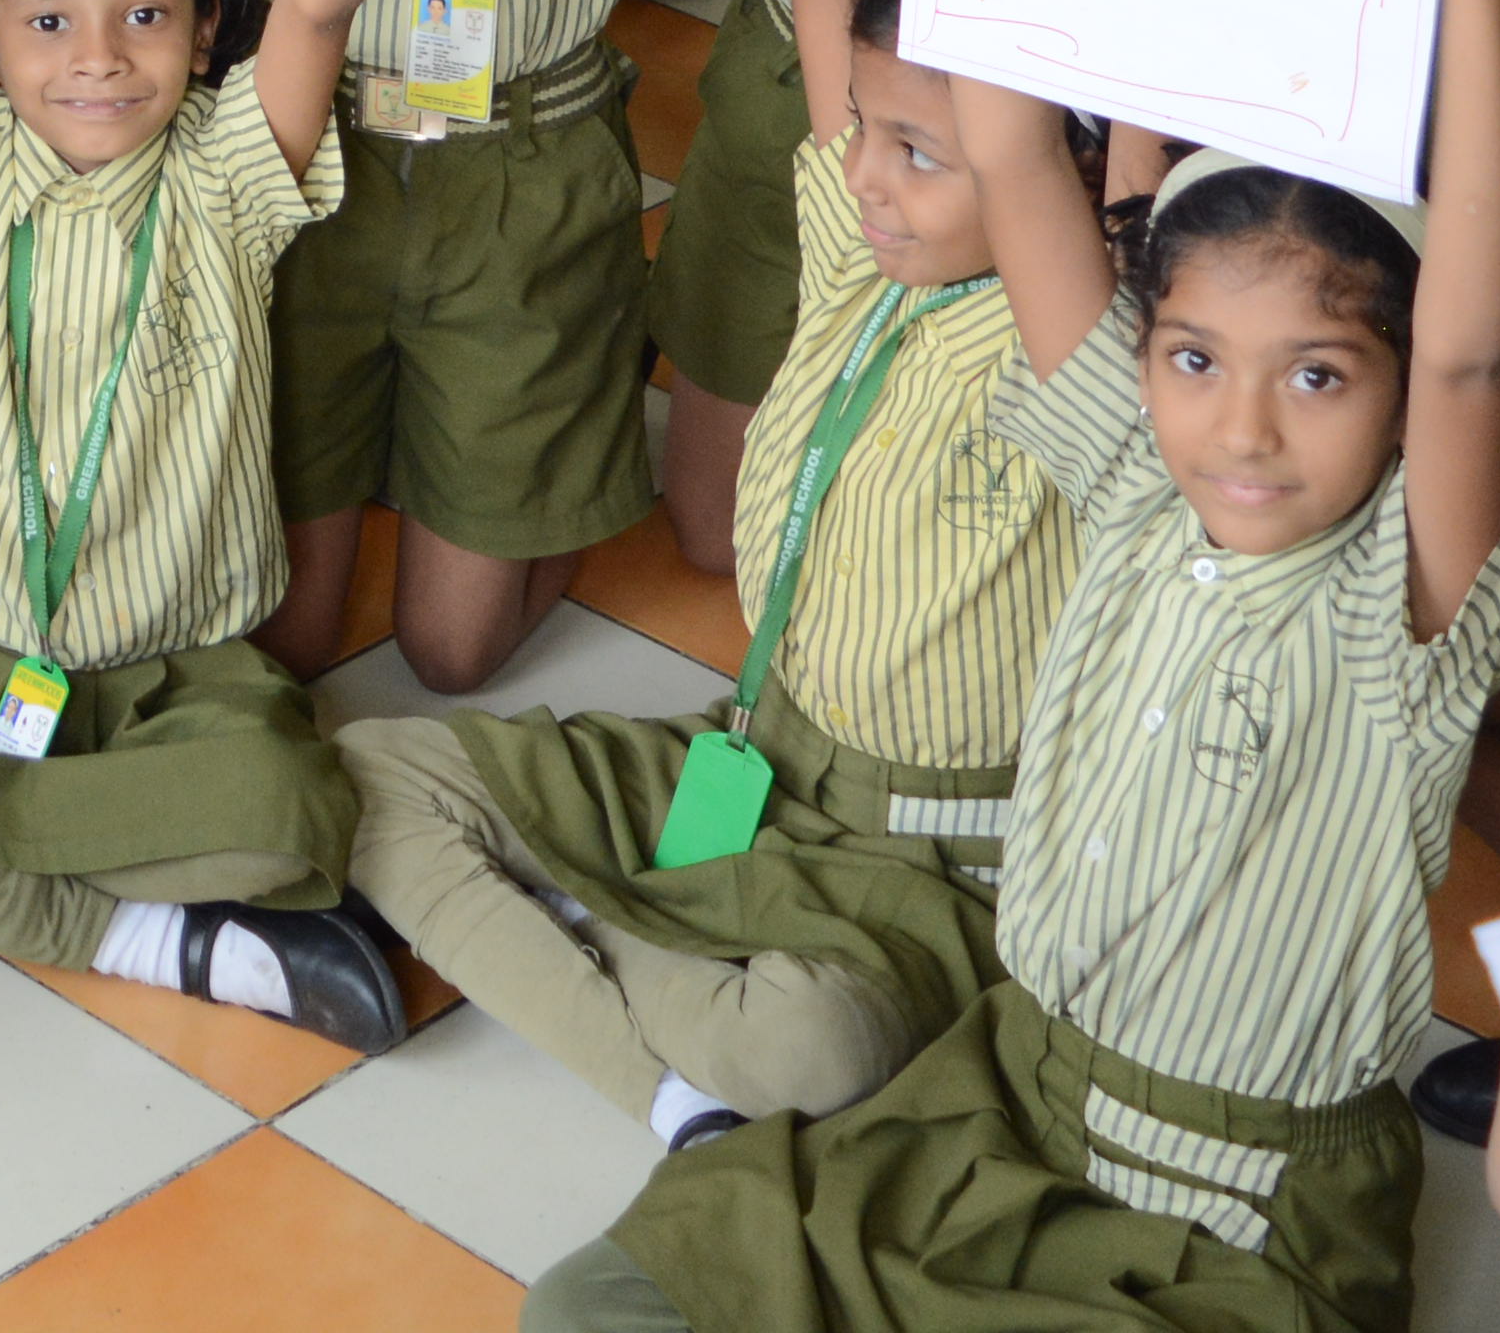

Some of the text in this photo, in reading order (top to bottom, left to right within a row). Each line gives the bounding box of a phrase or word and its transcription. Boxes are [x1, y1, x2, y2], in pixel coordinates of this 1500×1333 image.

[841, 283, 901, 381] GREENWOOD
[75, 389, 111, 502] GREENWOODS
[797, 445, 824, 513] SCHOOL
[20, 473, 38, 541] SCHOOL
[1195, 739, 1261, 767] GREENWOO
